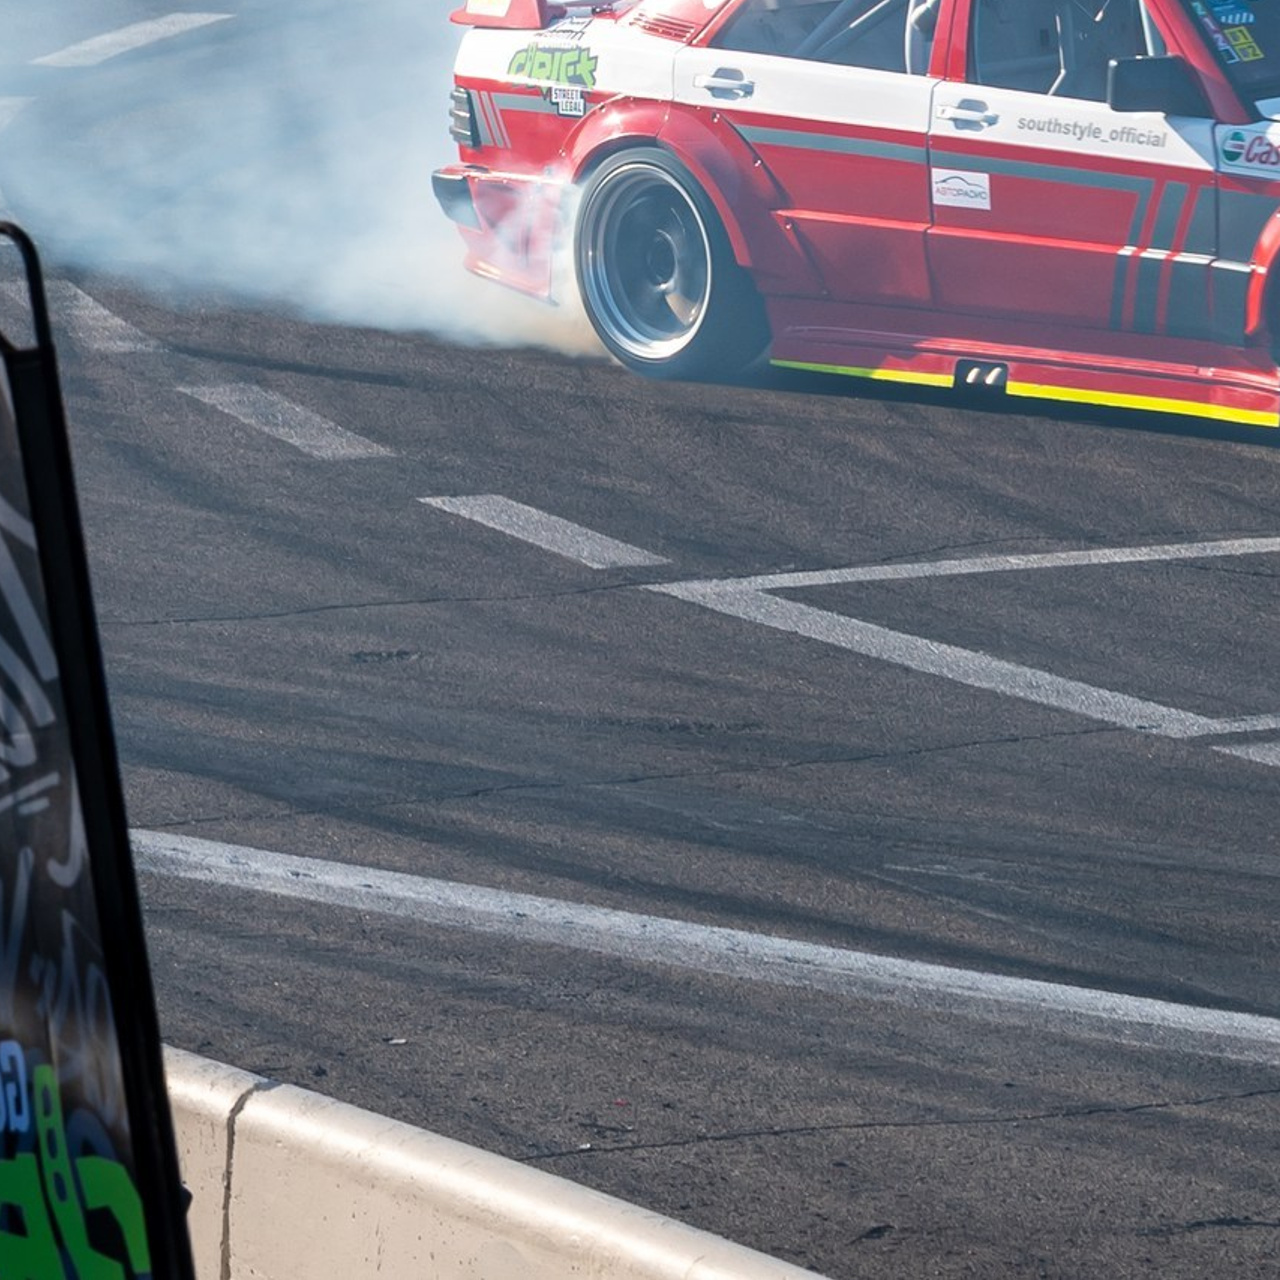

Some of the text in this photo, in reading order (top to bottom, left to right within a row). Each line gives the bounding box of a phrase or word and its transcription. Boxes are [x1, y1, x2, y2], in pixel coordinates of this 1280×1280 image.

[553, 87, 581, 102] STREET
[561, 100, 583, 113] LEGAL
[1017, 116, 1167, 148] southstyle_official
